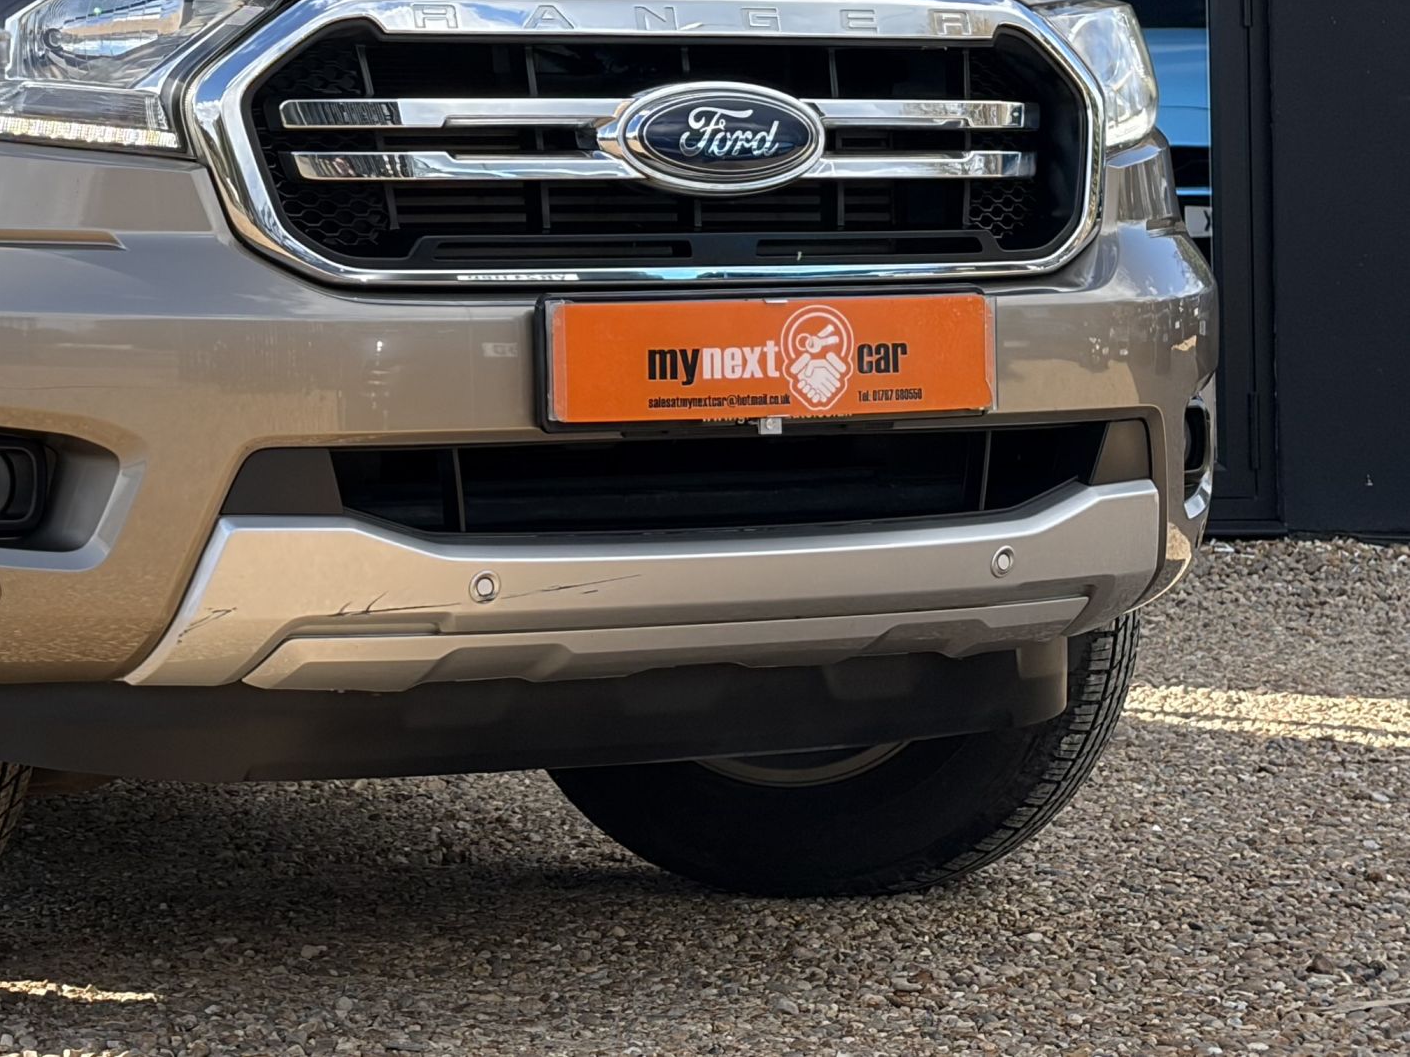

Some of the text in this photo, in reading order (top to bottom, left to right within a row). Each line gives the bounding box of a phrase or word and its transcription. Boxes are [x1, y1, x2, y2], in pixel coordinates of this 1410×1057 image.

[412, 3, 978, 36] RANGER
[679, 106, 780, 158] Ford
[647, 340, 908, 386] mynext car
